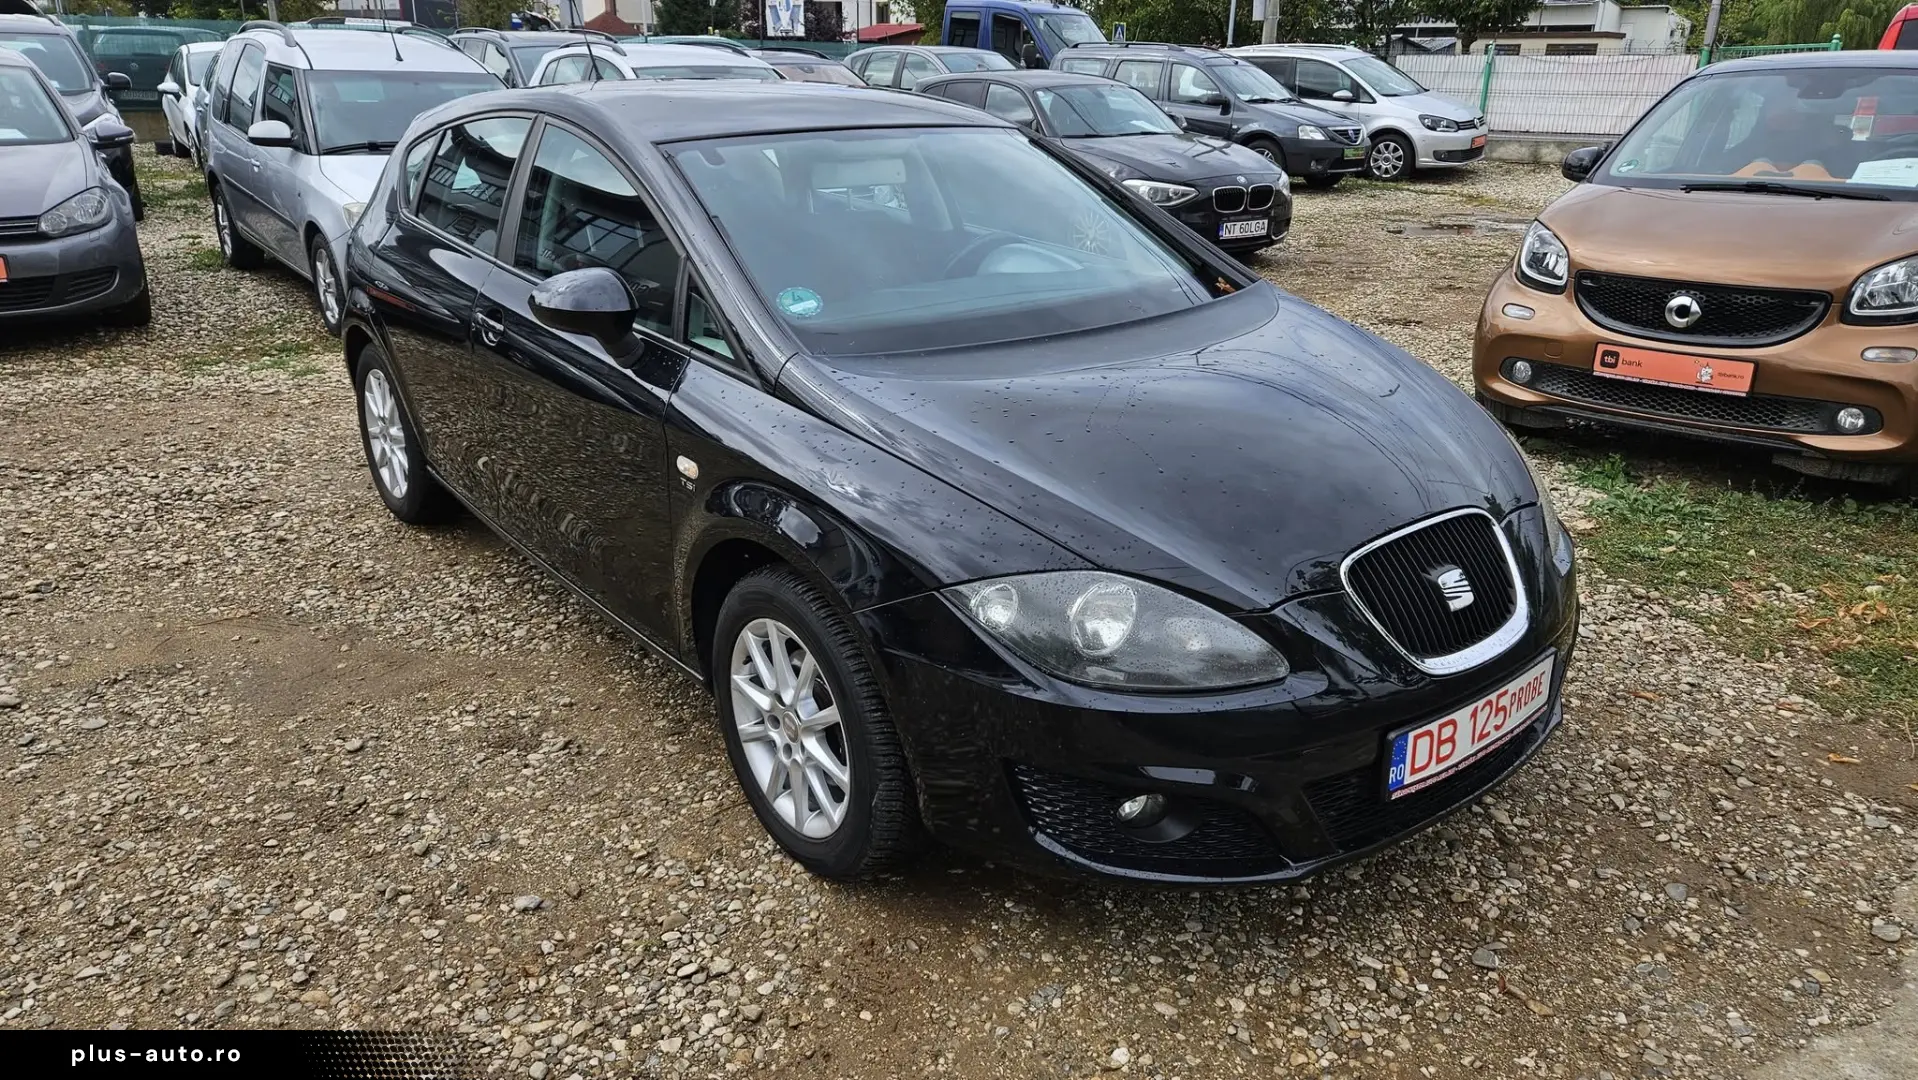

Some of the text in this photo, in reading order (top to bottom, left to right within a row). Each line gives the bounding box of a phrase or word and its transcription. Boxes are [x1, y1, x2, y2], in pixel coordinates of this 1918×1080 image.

[1224, 221, 1266, 236] NT 60LGA
[1604, 354, 1643, 368] tbi bank
[1409, 718, 1458, 777] DB
[1469, 688, 1509, 747] 125
[1508, 670, 1546, 719] PROBE
[1388, 763, 1405, 785] RO
